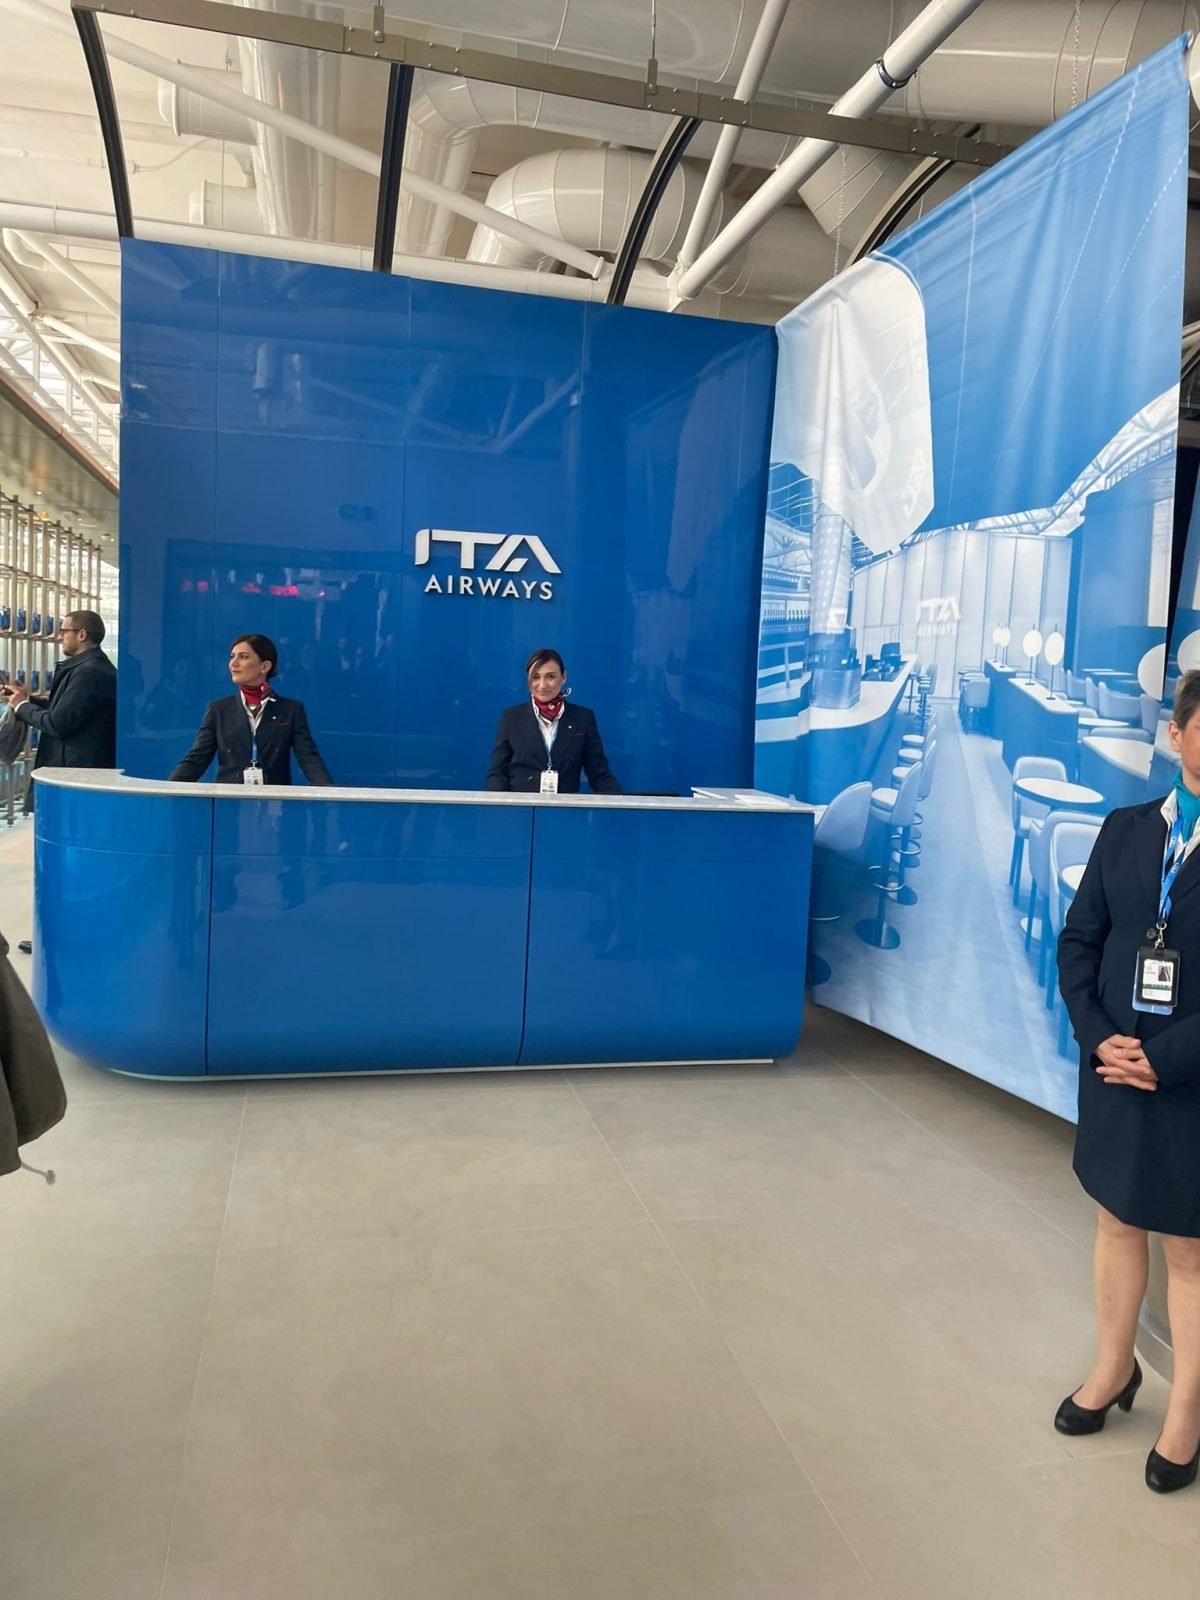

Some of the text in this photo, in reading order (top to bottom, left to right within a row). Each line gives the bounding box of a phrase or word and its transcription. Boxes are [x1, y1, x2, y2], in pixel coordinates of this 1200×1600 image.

[415, 528, 561, 574] ITA
[424, 574, 553, 600] AIRWAYS
[915, 596, 961, 623] ITA
